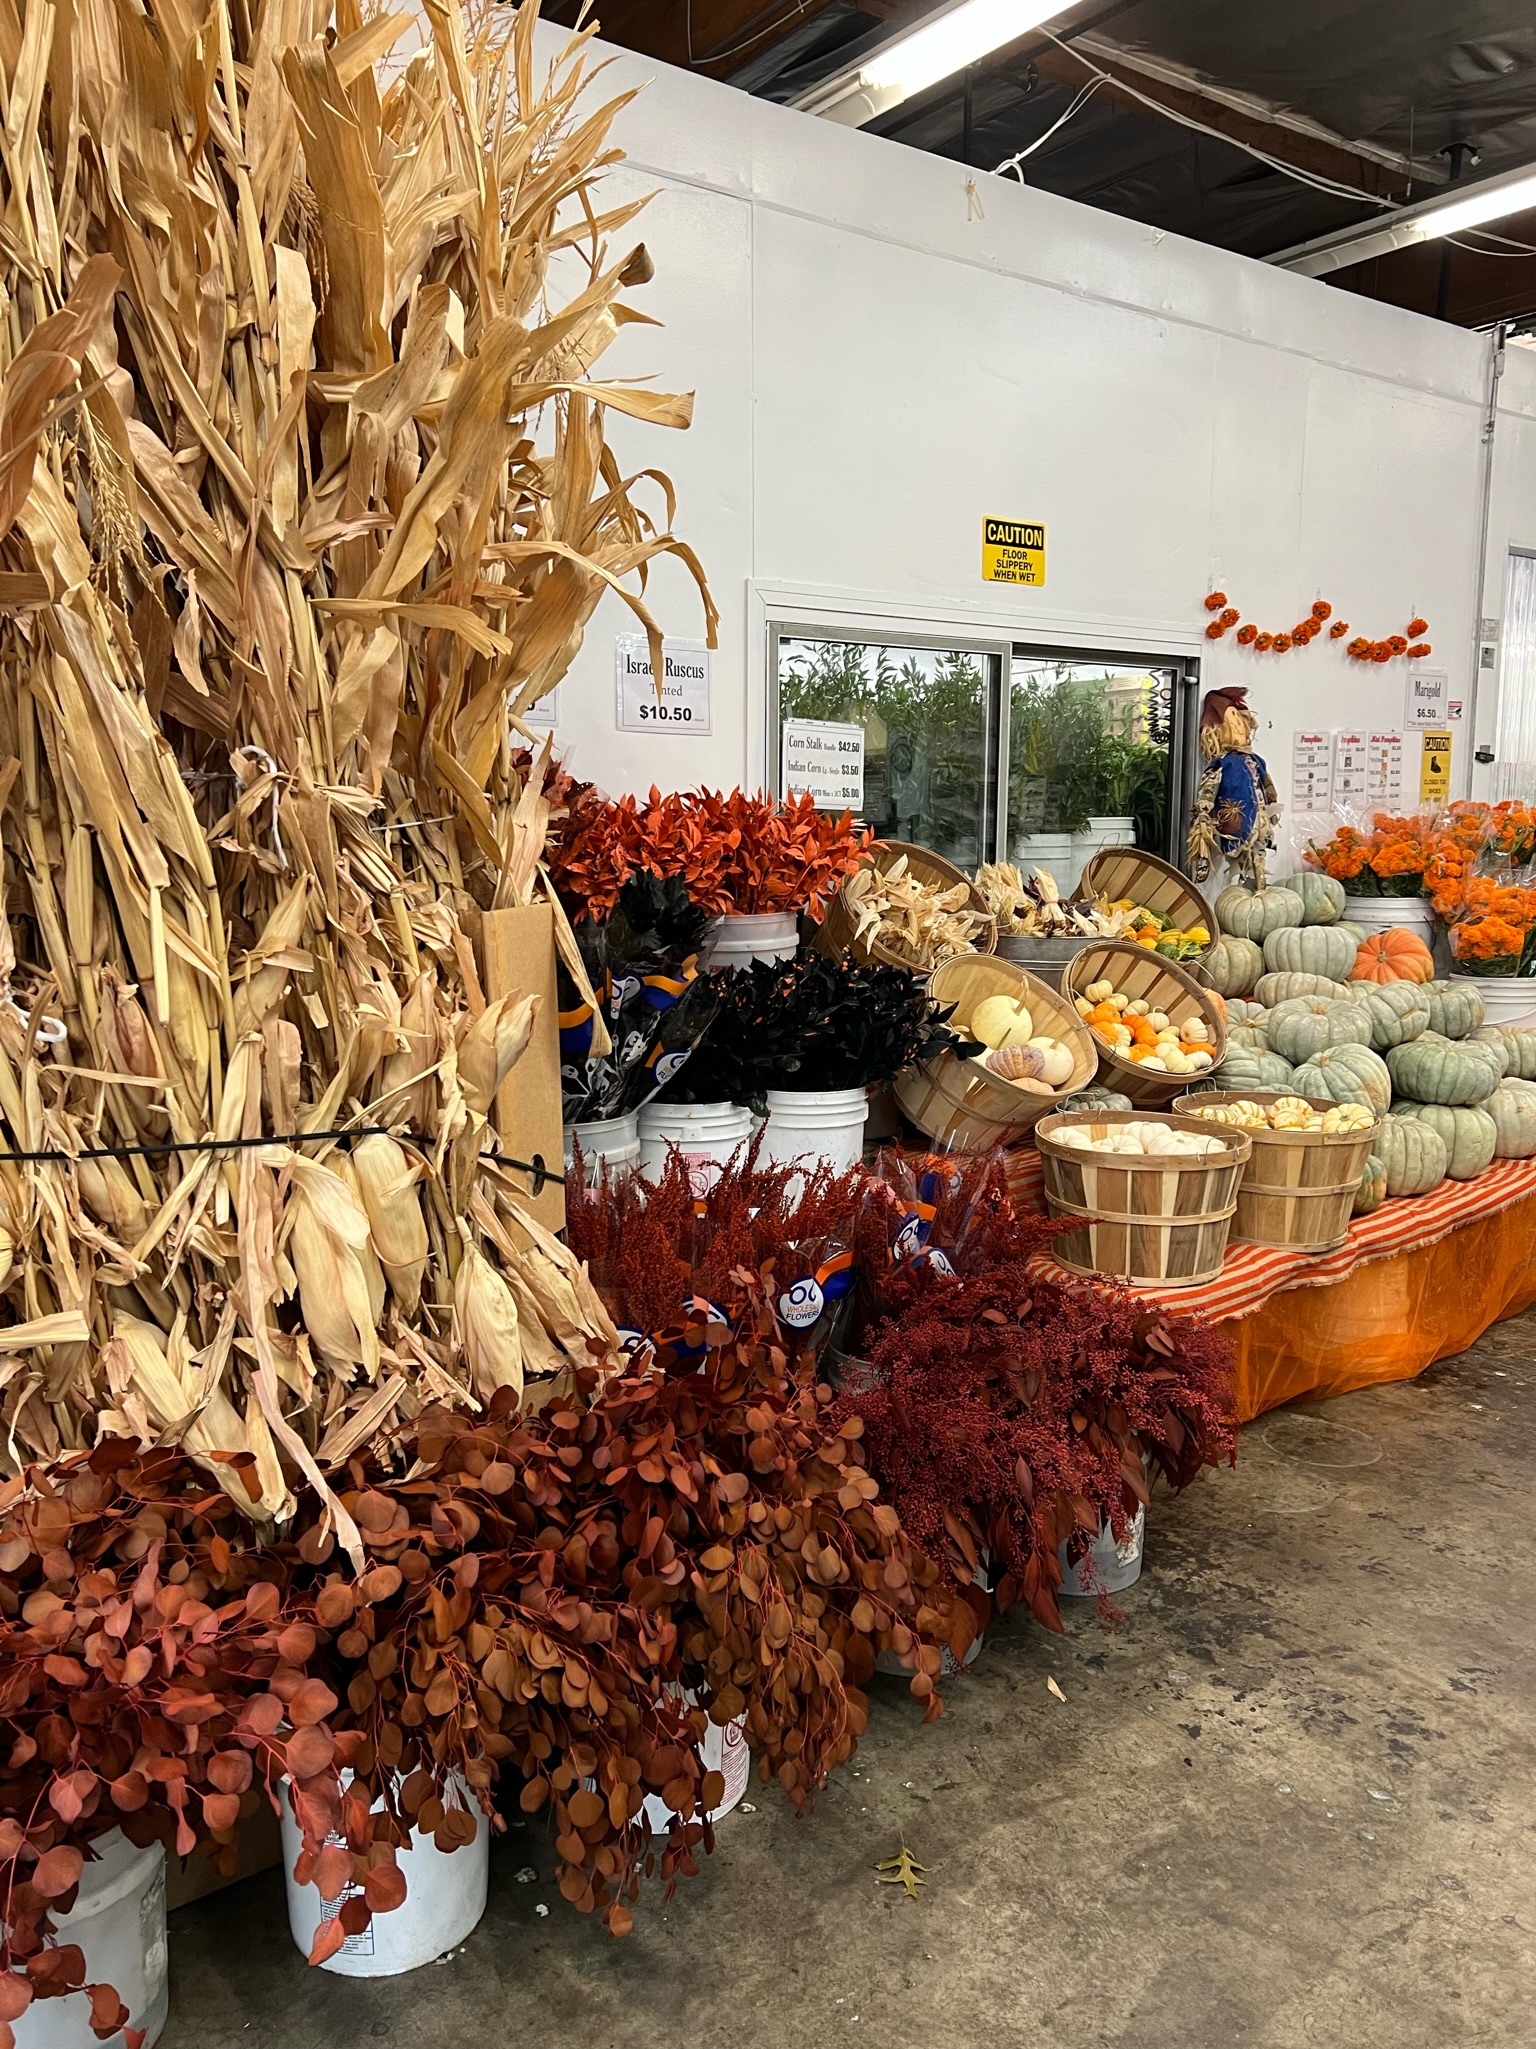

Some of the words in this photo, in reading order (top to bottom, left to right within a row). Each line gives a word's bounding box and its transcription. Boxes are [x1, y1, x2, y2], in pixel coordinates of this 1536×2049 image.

[987, 523, 1042, 547] CAUTION
[1003, 549, 1027, 560] FLOOR
[996, 559, 1033, 571] SLIPPERY
[994, 569, 1017, 580] WHEN
[1019, 572, 1036, 582] WET
[626, 654, 654, 675] Israe
[665, 657, 704, 679] Ruscus
[649, 683, 683, 696] Tnted
[1415, 681, 1441, 700] Marigold
[639, 705, 692, 721] $10.50
[1417, 708, 1436, 718] $6.50
[789, 735, 805, 748] Corn
[806, 737, 822, 750] Stalk
[838, 741, 860, 752] $42.50
[1425, 738, 1449, 750] CAUTION
[788, 760, 806, 772] Indian
[807, 761, 821, 773] Corn
[841, 764, 859, 775] $3.50
[842, 787, 859, 798] $5.00
[786, 1310, 820, 1320] FLOWERS
